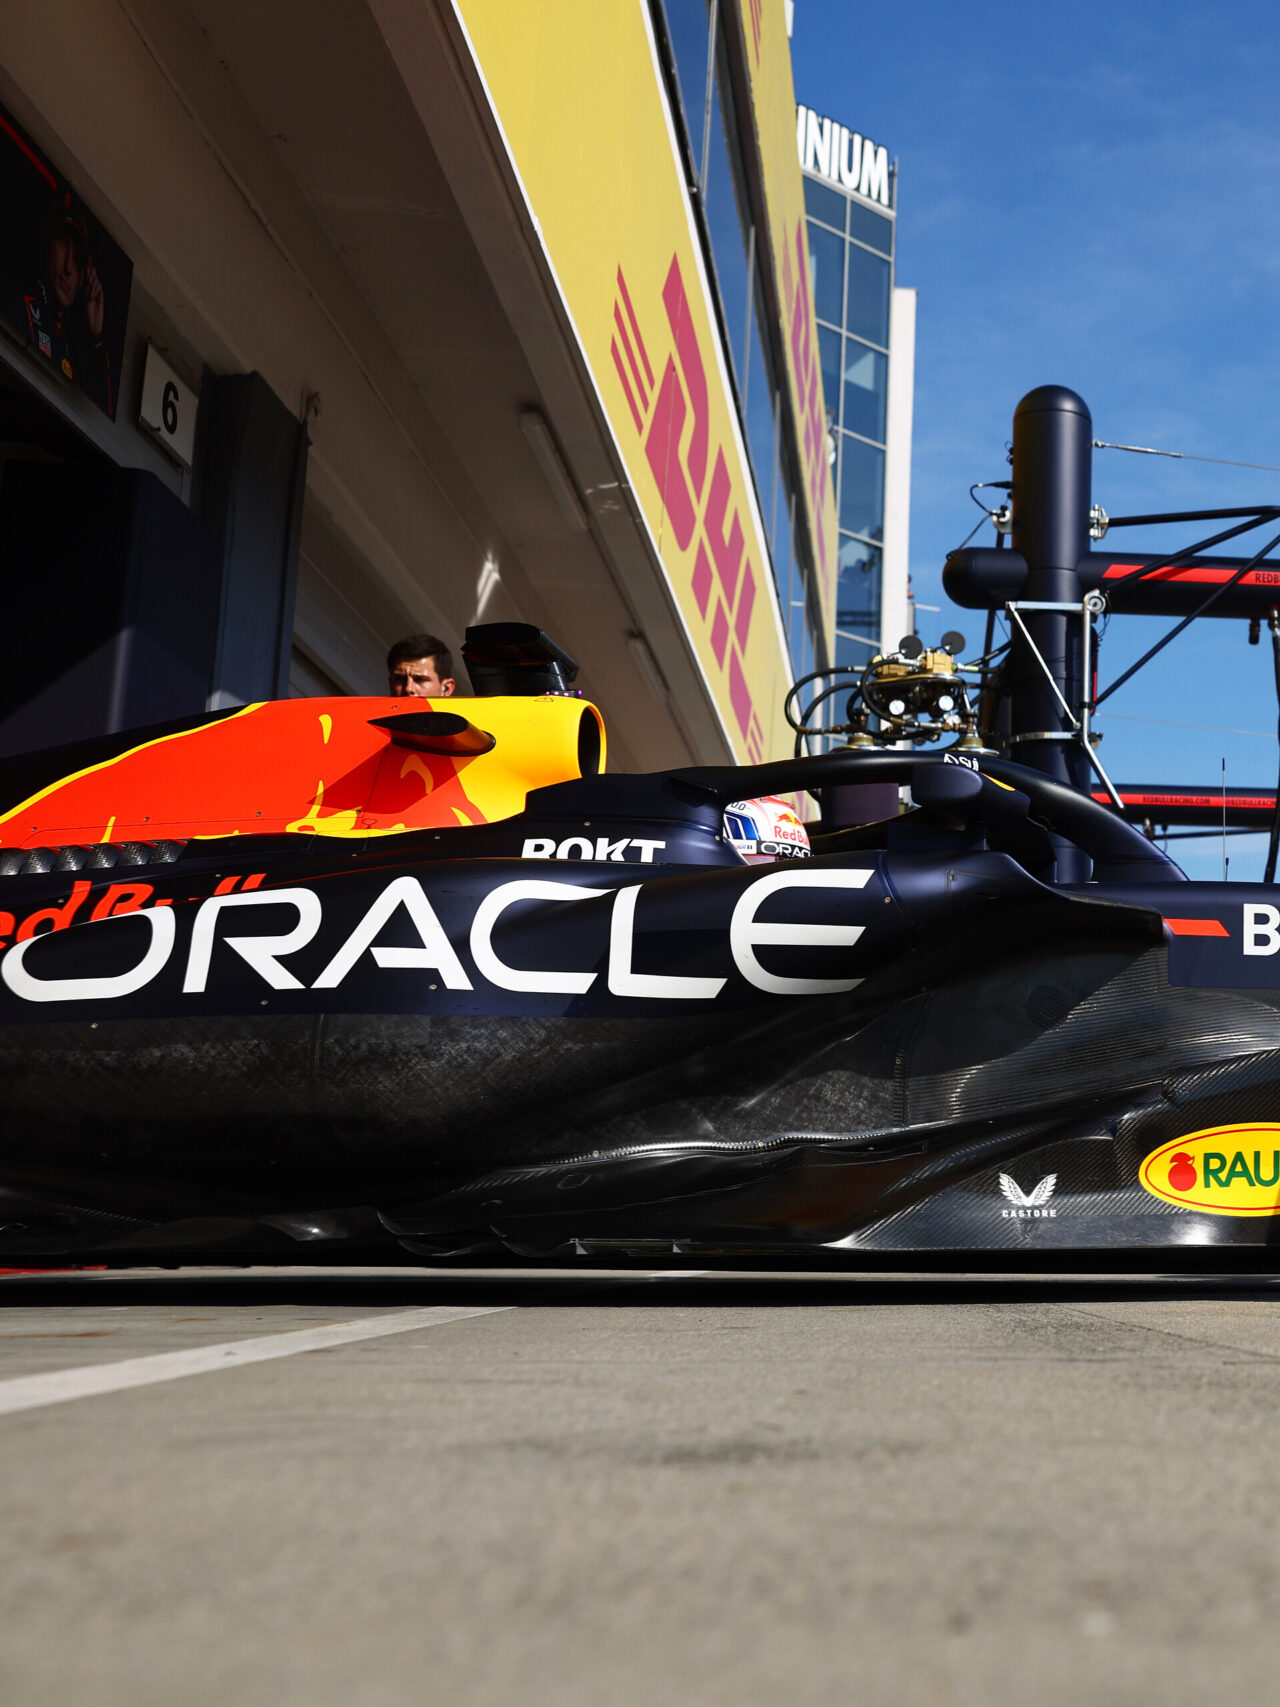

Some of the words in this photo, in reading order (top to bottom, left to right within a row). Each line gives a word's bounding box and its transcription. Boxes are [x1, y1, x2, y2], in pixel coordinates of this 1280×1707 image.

[162, 381, 180, 436] 6
[645, 251, 757, 748] DHL
[521, 836, 667, 863] ROKT
[774, 826, 797, 841] Red
[1, 868, 877, 1002] ORACLE
[1002, 1209, 1058, 1219] CASTORE
